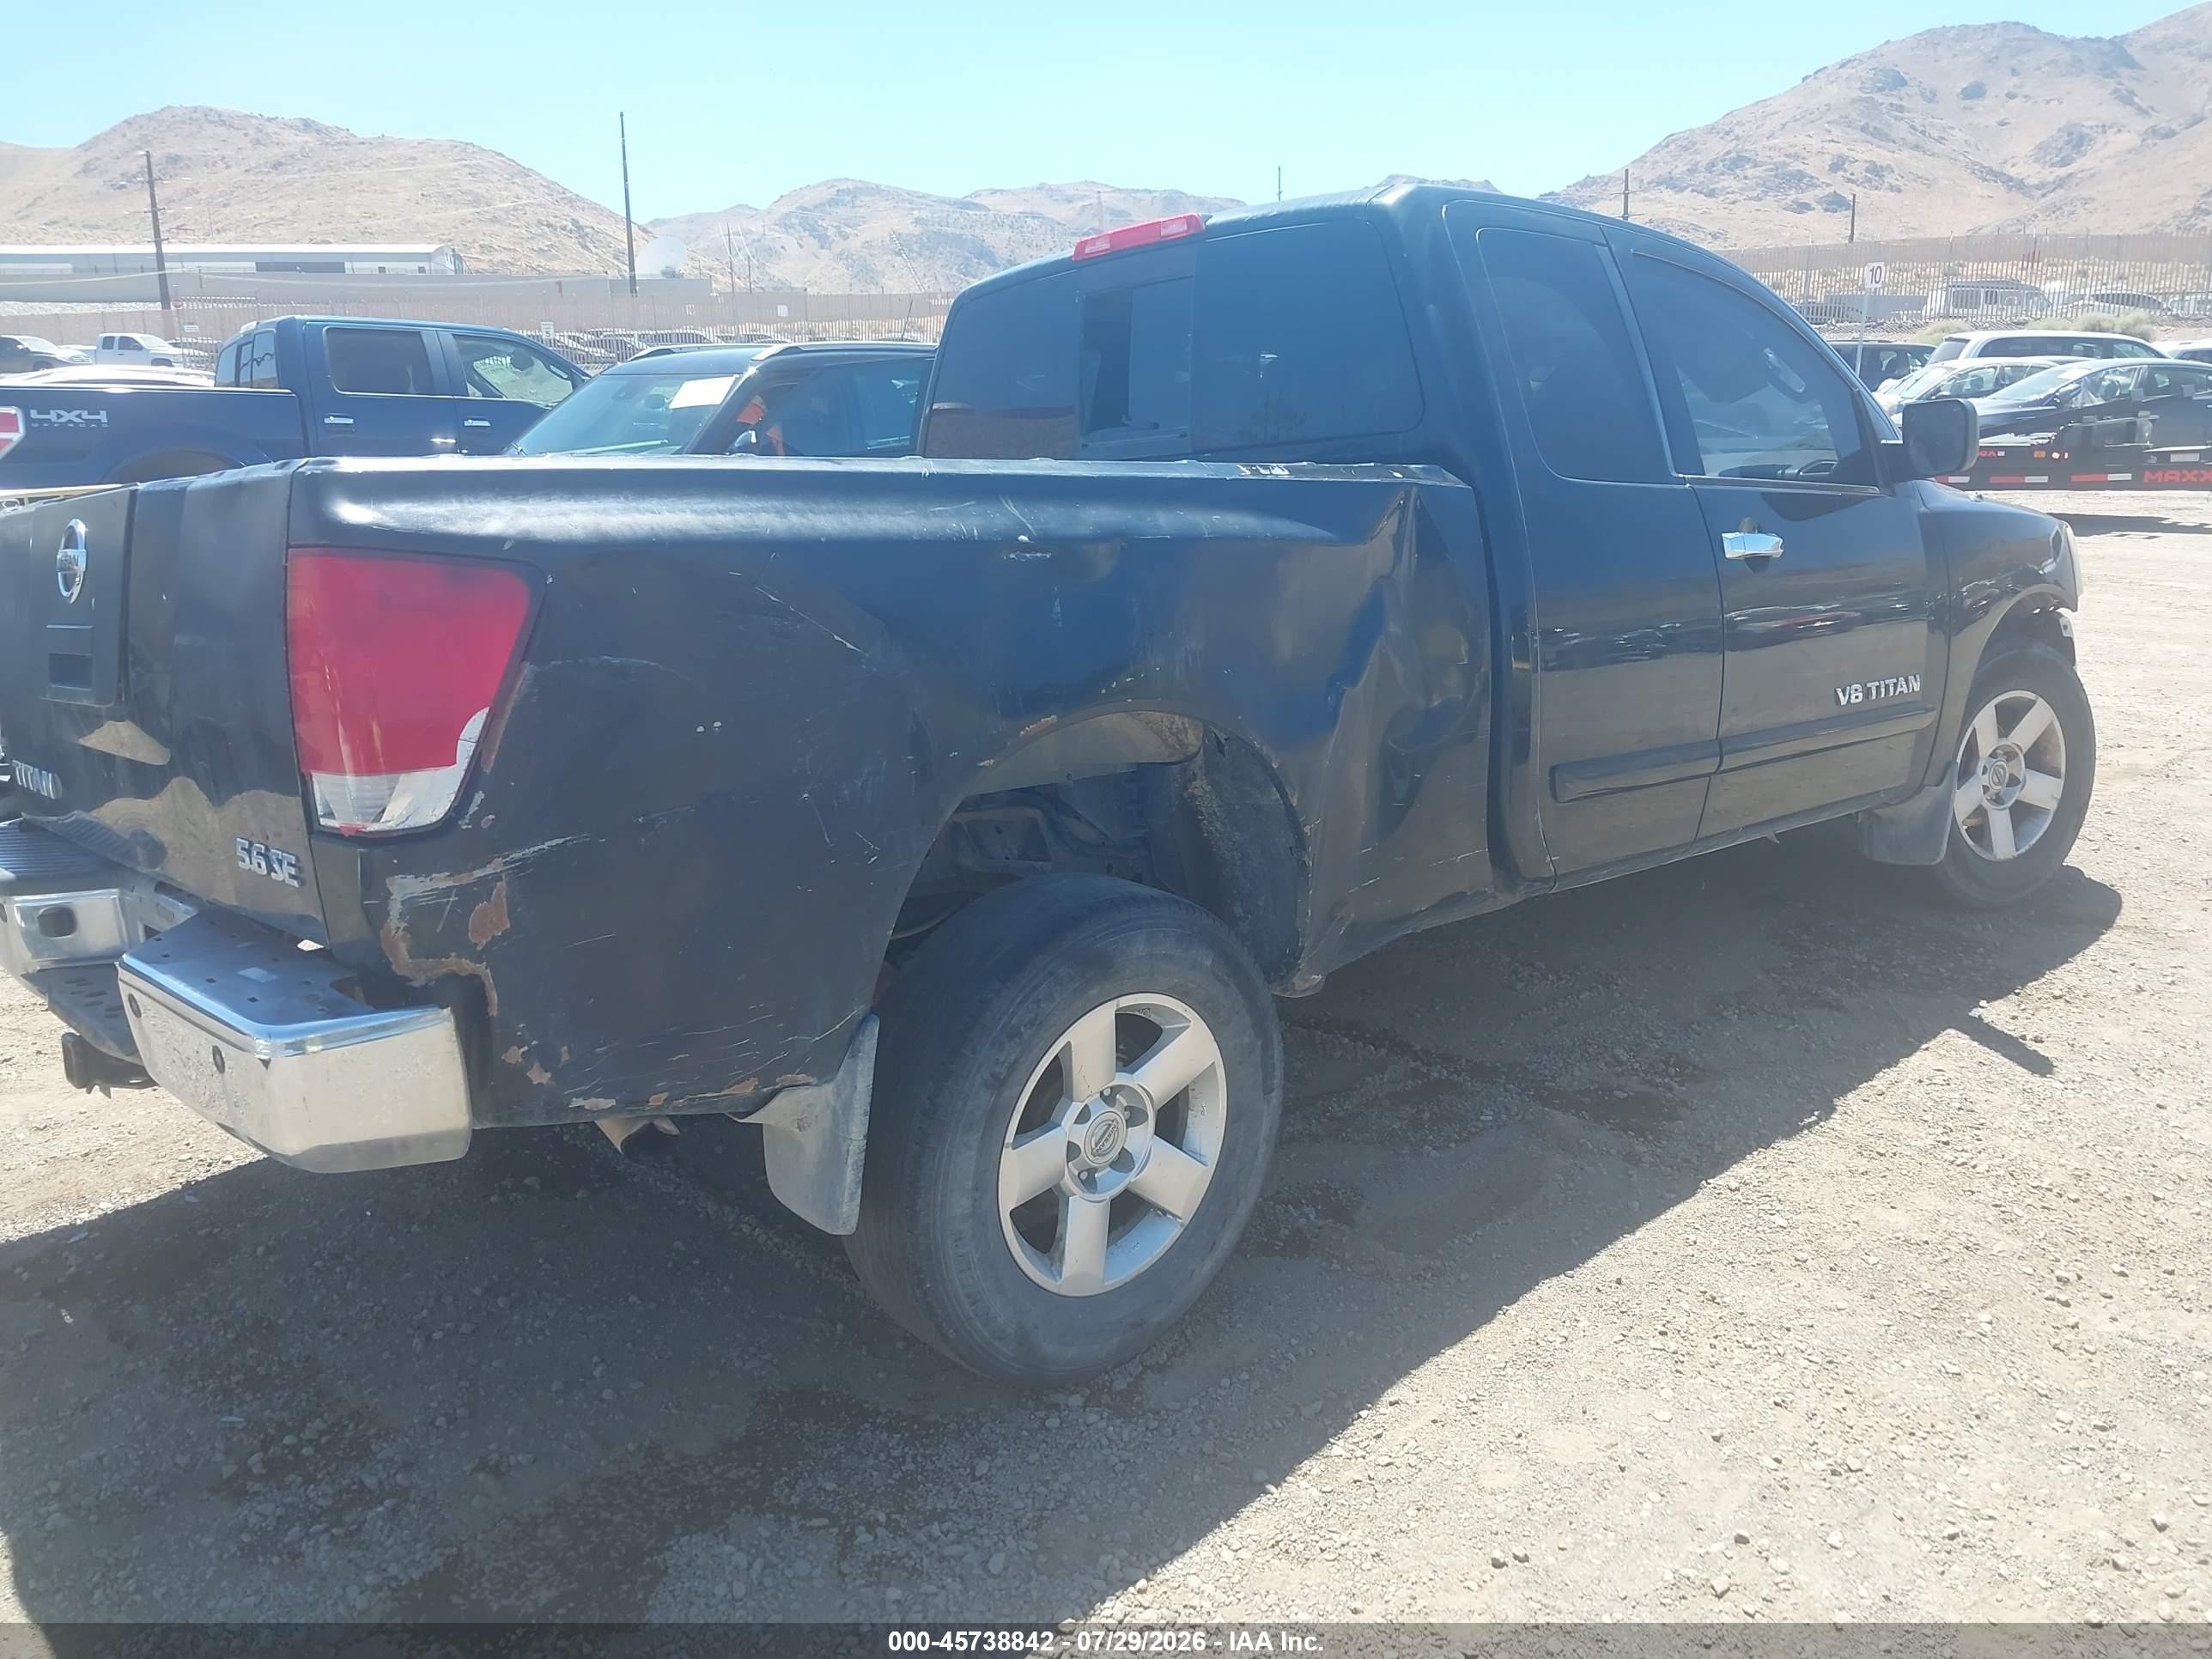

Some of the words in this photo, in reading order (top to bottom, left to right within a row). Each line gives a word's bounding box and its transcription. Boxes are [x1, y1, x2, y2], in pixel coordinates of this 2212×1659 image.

[1869, 265, 1882, 284] 10
[29, 409, 108, 423] 4X4
[1866, 673, 1921, 700] TITAN
[11, 759, 56, 799] TITAN
[270, 848, 300, 888] SE
[1096, 1123, 1118, 1153] NISSAN
